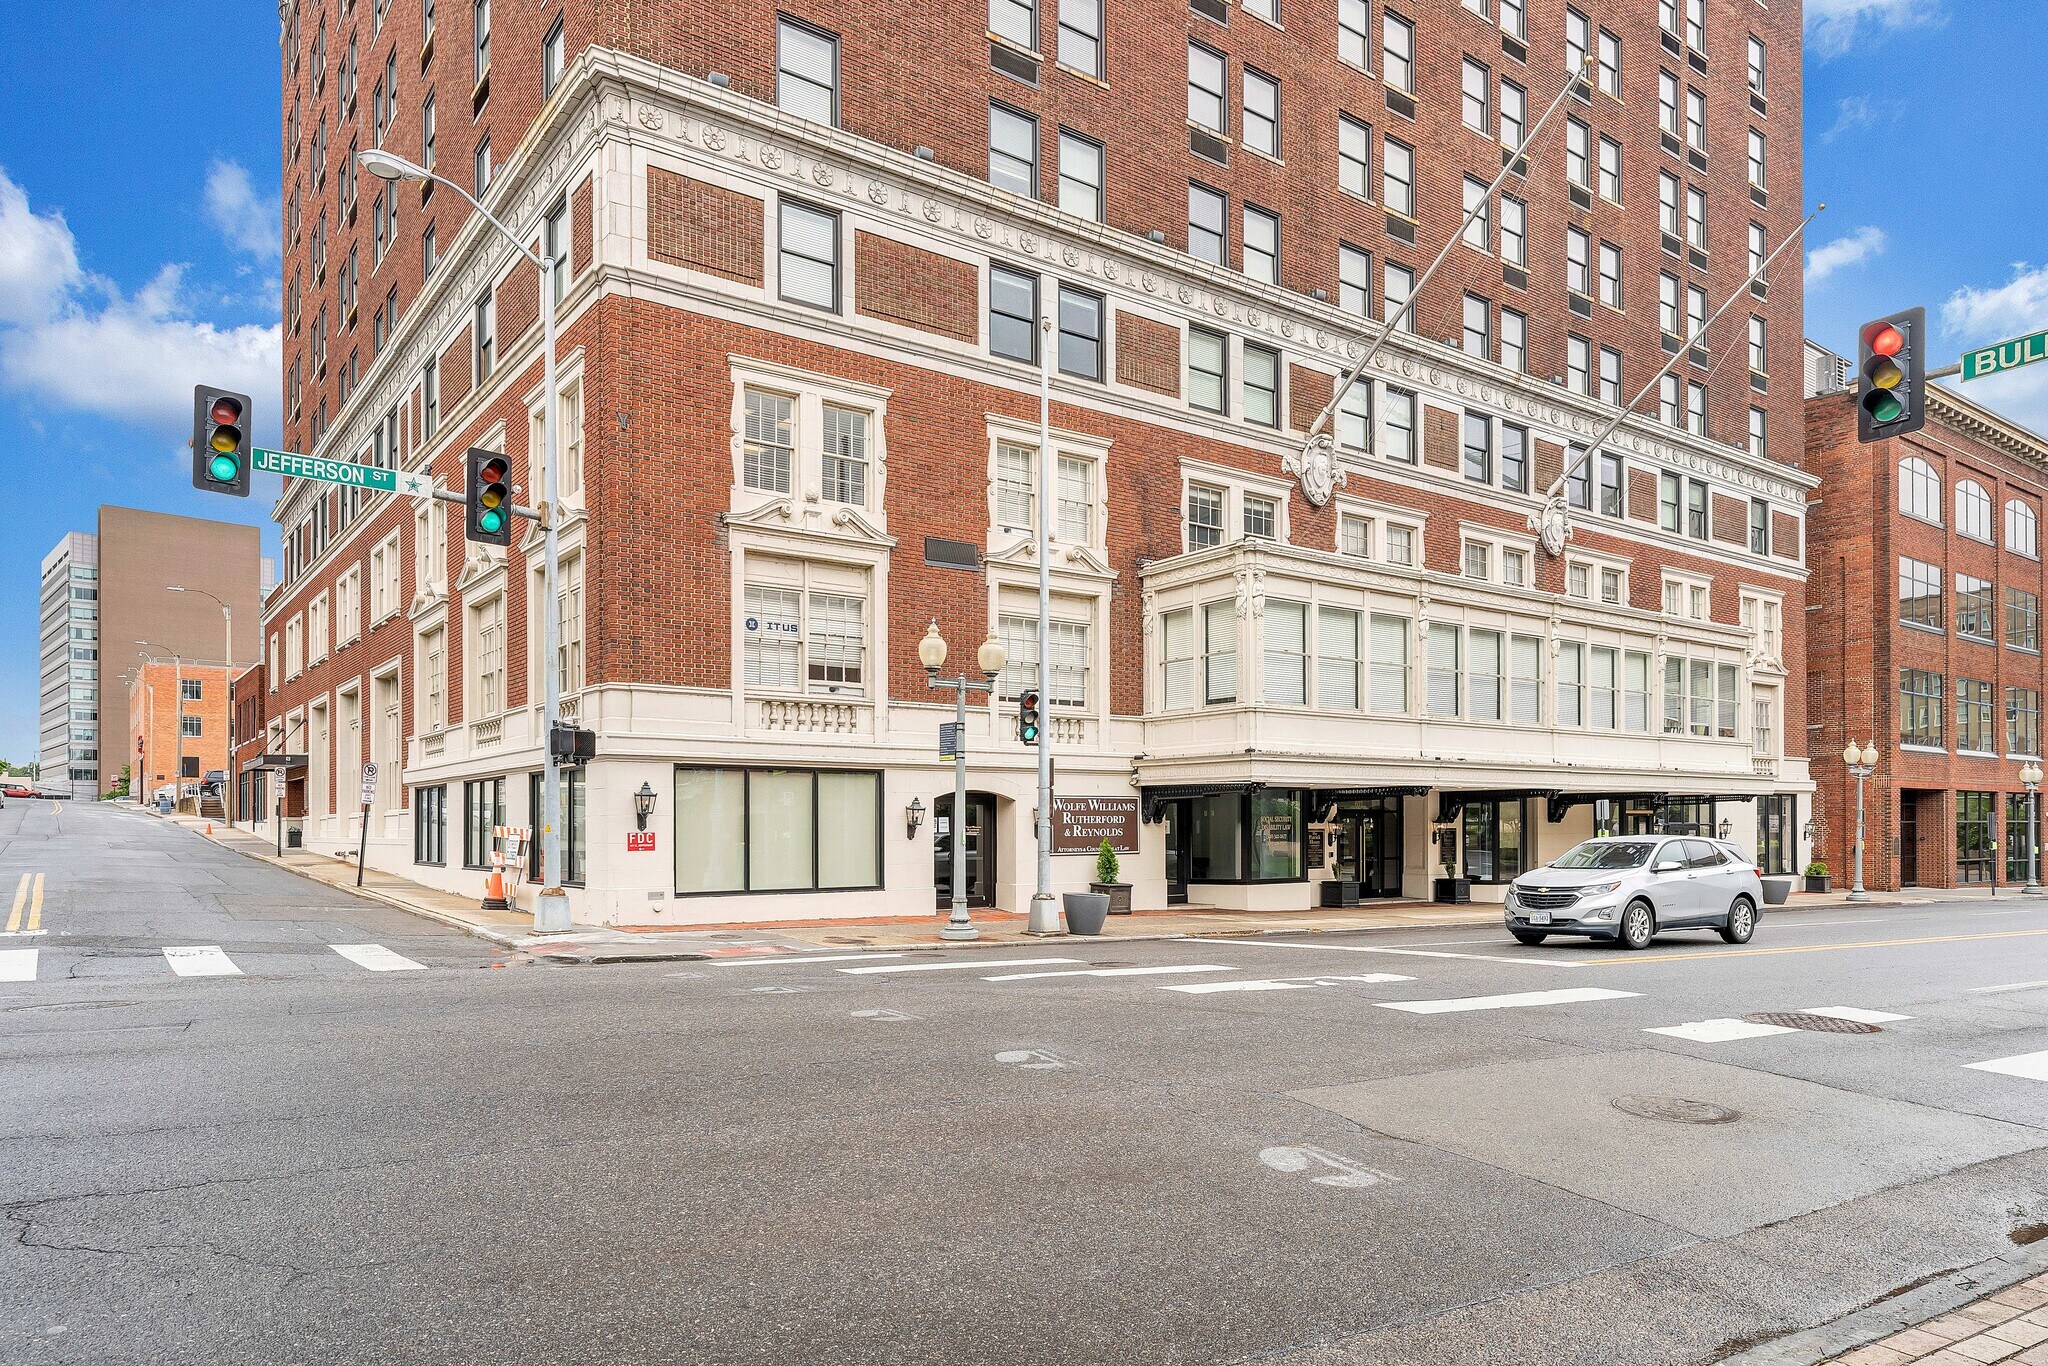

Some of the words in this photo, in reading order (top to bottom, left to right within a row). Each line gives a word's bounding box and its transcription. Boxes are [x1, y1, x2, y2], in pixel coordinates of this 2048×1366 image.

[1975, 334, 2048, 376] BUL
[257, 451, 364, 484] JEFFERSON
[372, 471, 389, 482] ST
[767, 622, 798, 632] ITUS
[1053, 799, 1087, 811] WOLFE
[1088, 799, 1136, 811] WILLIAMS
[1063, 812, 1125, 824] RUTHERFORD
[1064, 828, 1072, 837] &
[1073, 824, 1124, 837] REYNOLDS
[629, 833, 653, 843] FDC
